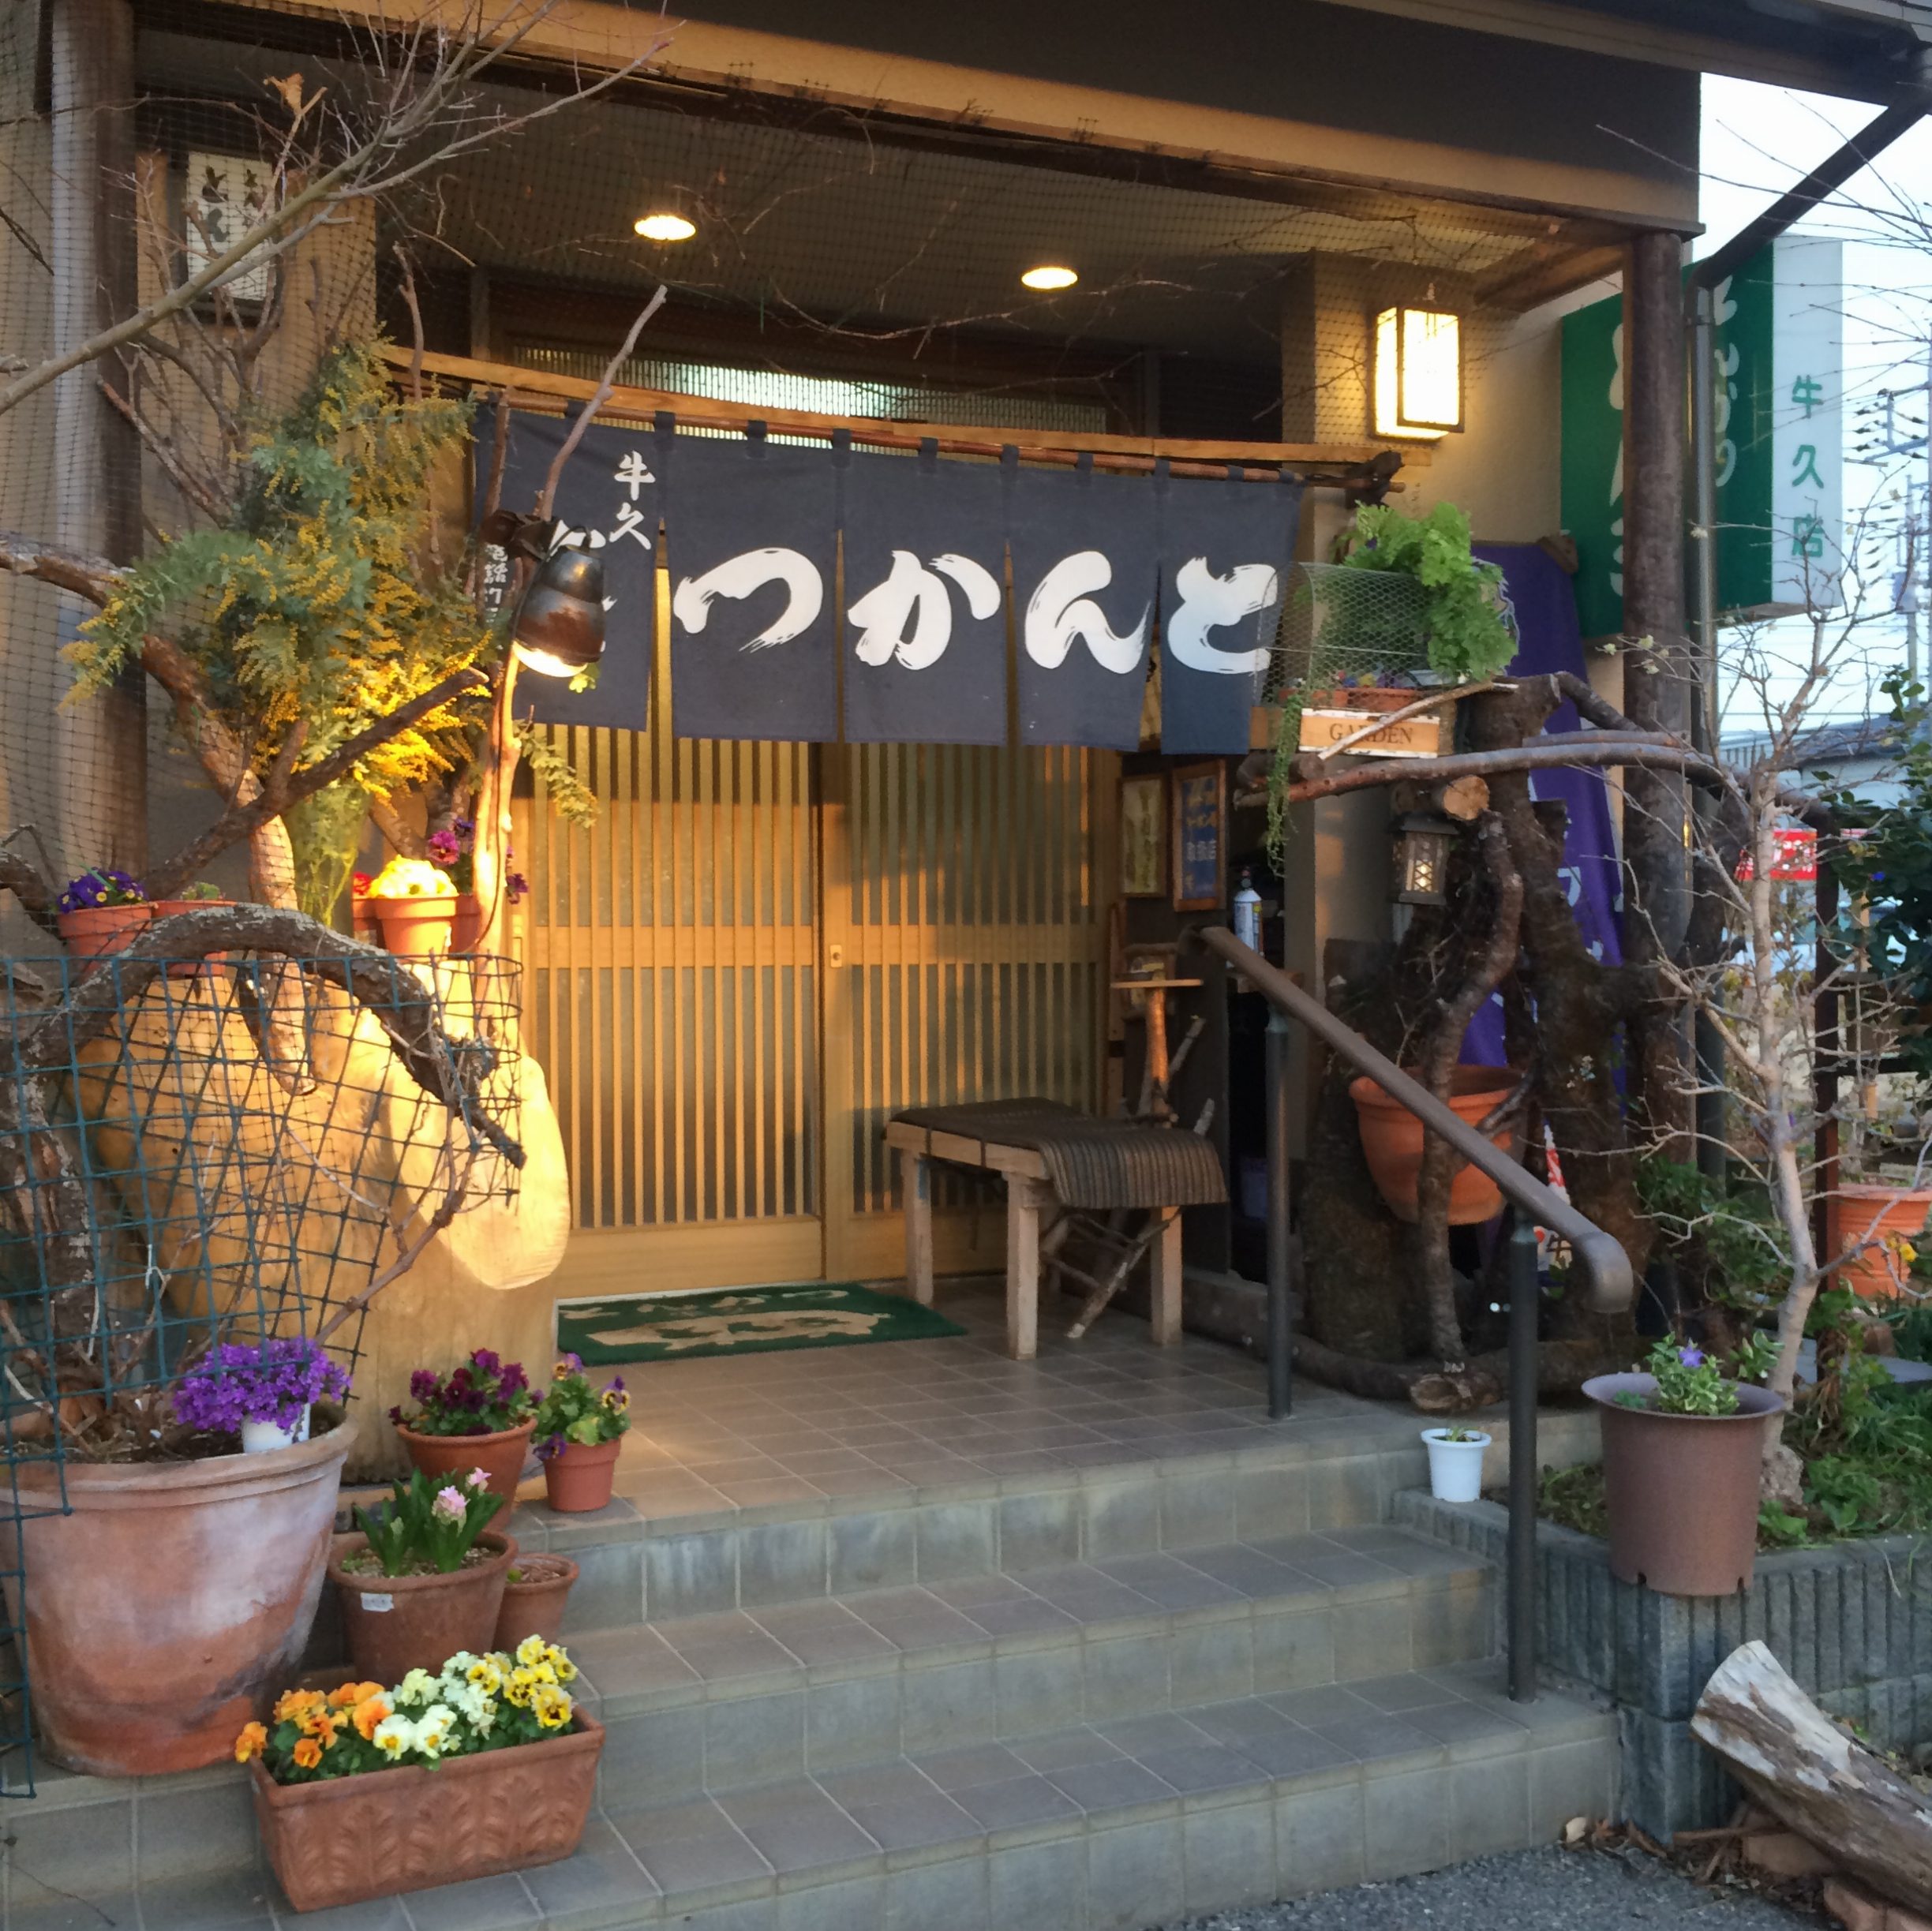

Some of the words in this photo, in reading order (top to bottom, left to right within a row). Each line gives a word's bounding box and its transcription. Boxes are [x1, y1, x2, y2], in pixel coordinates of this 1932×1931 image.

[609, 450, 656, 550] 牛久
[1791, 374, 1825, 558] 牛久店
